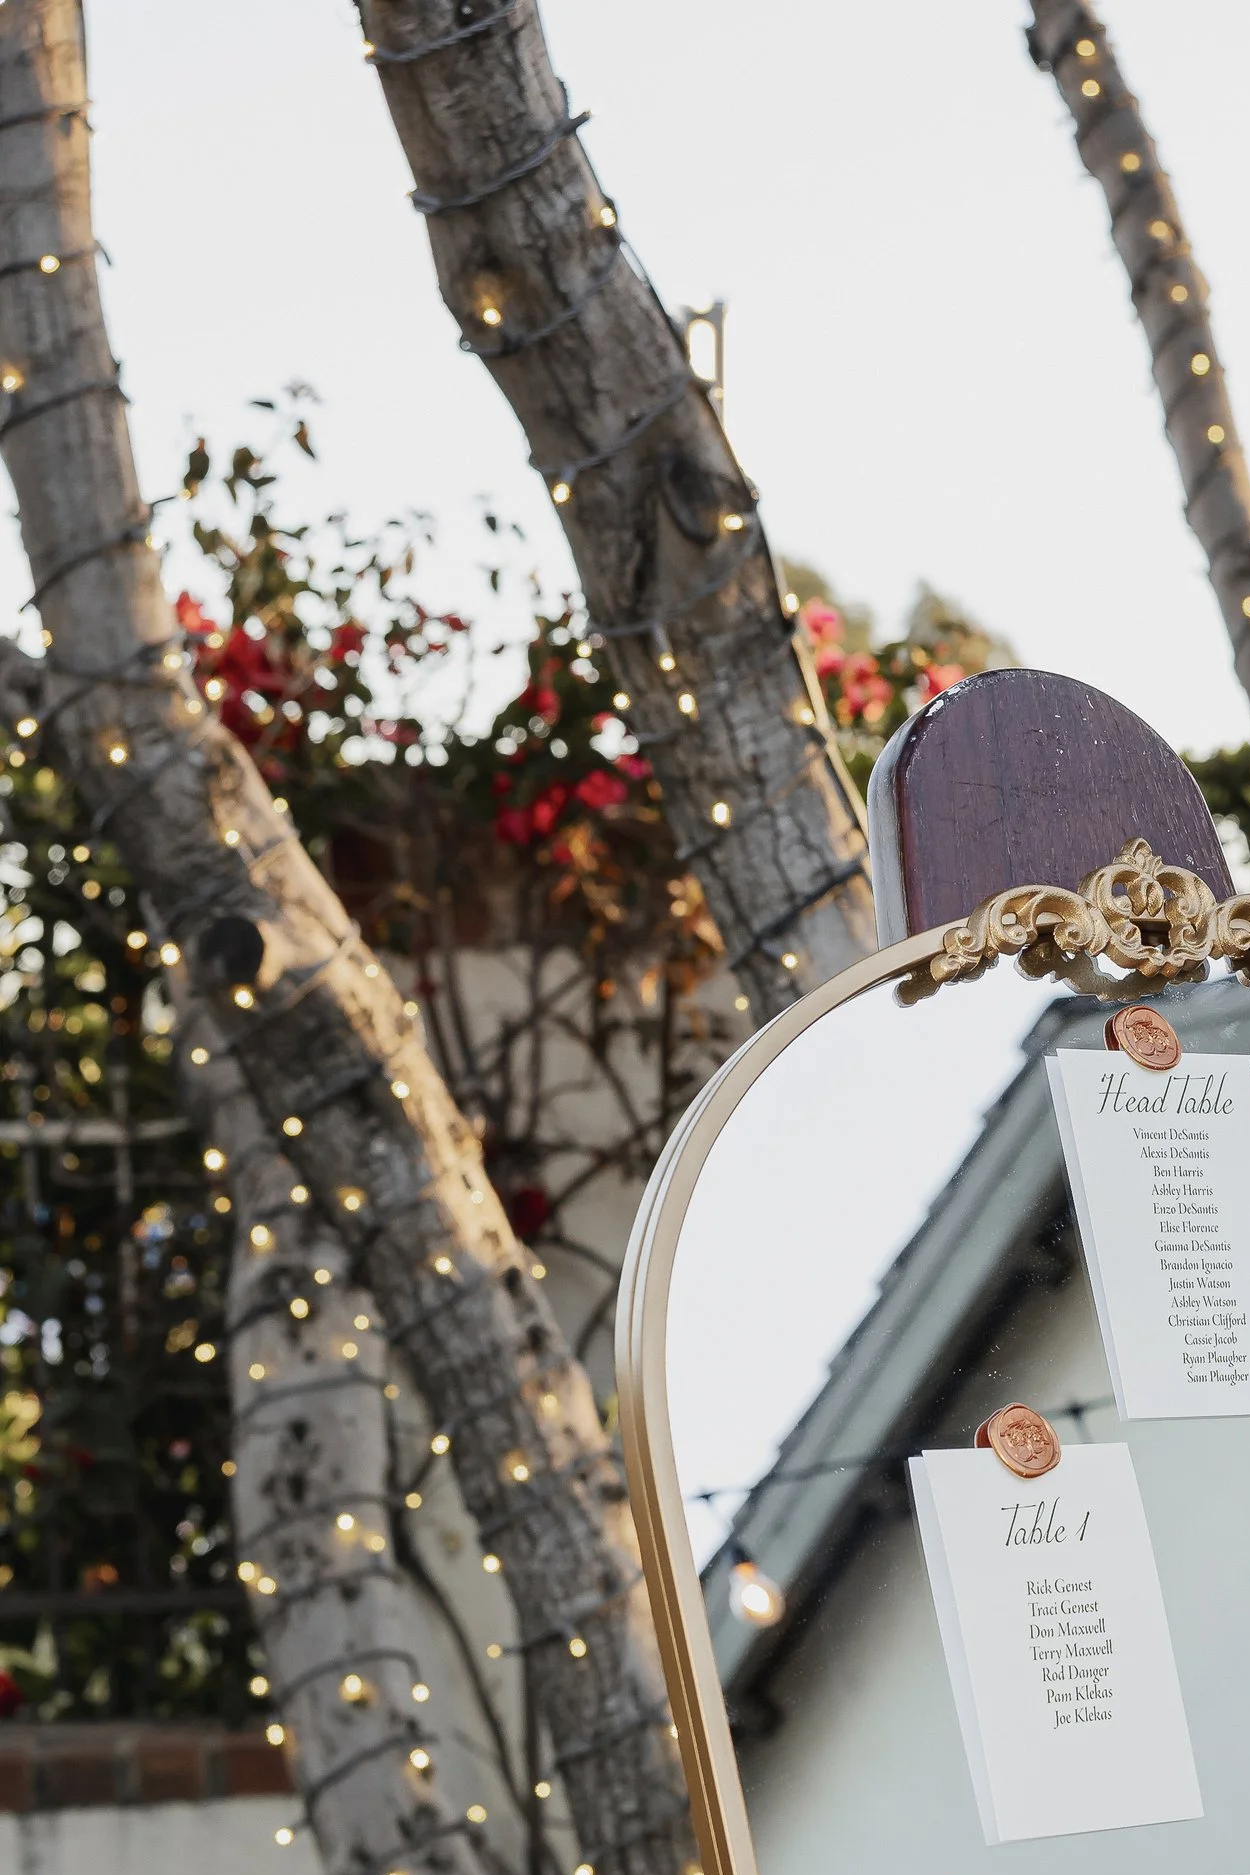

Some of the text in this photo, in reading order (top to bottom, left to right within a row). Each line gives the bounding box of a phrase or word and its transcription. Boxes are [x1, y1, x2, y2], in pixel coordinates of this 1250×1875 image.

[1096, 1071, 1235, 1115] Head Table
[1132, 1127, 1210, 1141] Vincent DeSantis
[1140, 1145, 1210, 1160] Alexis DeSantis
[1153, 1164, 1204, 1178] Ben Harris
[1151, 1183, 1214, 1201] Ashley Harris
[1177, 1202, 1219, 1215] DeSantis
[1159, 1220, 1219, 1233] Elise Florence
[1154, 1239, 1232, 1253] Gianna DeSantis
[1160, 1257, 1233, 1275] Brandon Ignacio
[1168, 1276, 1231, 1293] Justin Watson
[1170, 1295, 1237, 1313] Ashley Watson
[1168, 1312, 1247, 1331] Christian Clifford
[1184, 1331, 1238, 1349] Cassie Jacob
[1182, 1350, 1247, 1369] Ryan Plaugher
[1186, 1368, 1249, 1387] Sam Plaugher
[1000, 1496, 1091, 1548] Table 1
[1026, 1577, 1093, 1596] Rick Genest
[1027, 1599, 1099, 1617] Traci Genest
[1029, 1617, 1106, 1640] Don Maxwell
[1029, 1638, 1113, 1665] Terry Maxwell
[1042, 1664, 1110, 1684] Rod Danger
[1046, 1683, 1113, 1704] Pam Klekas
[1053, 1705, 1113, 1730] Joe Klekas
